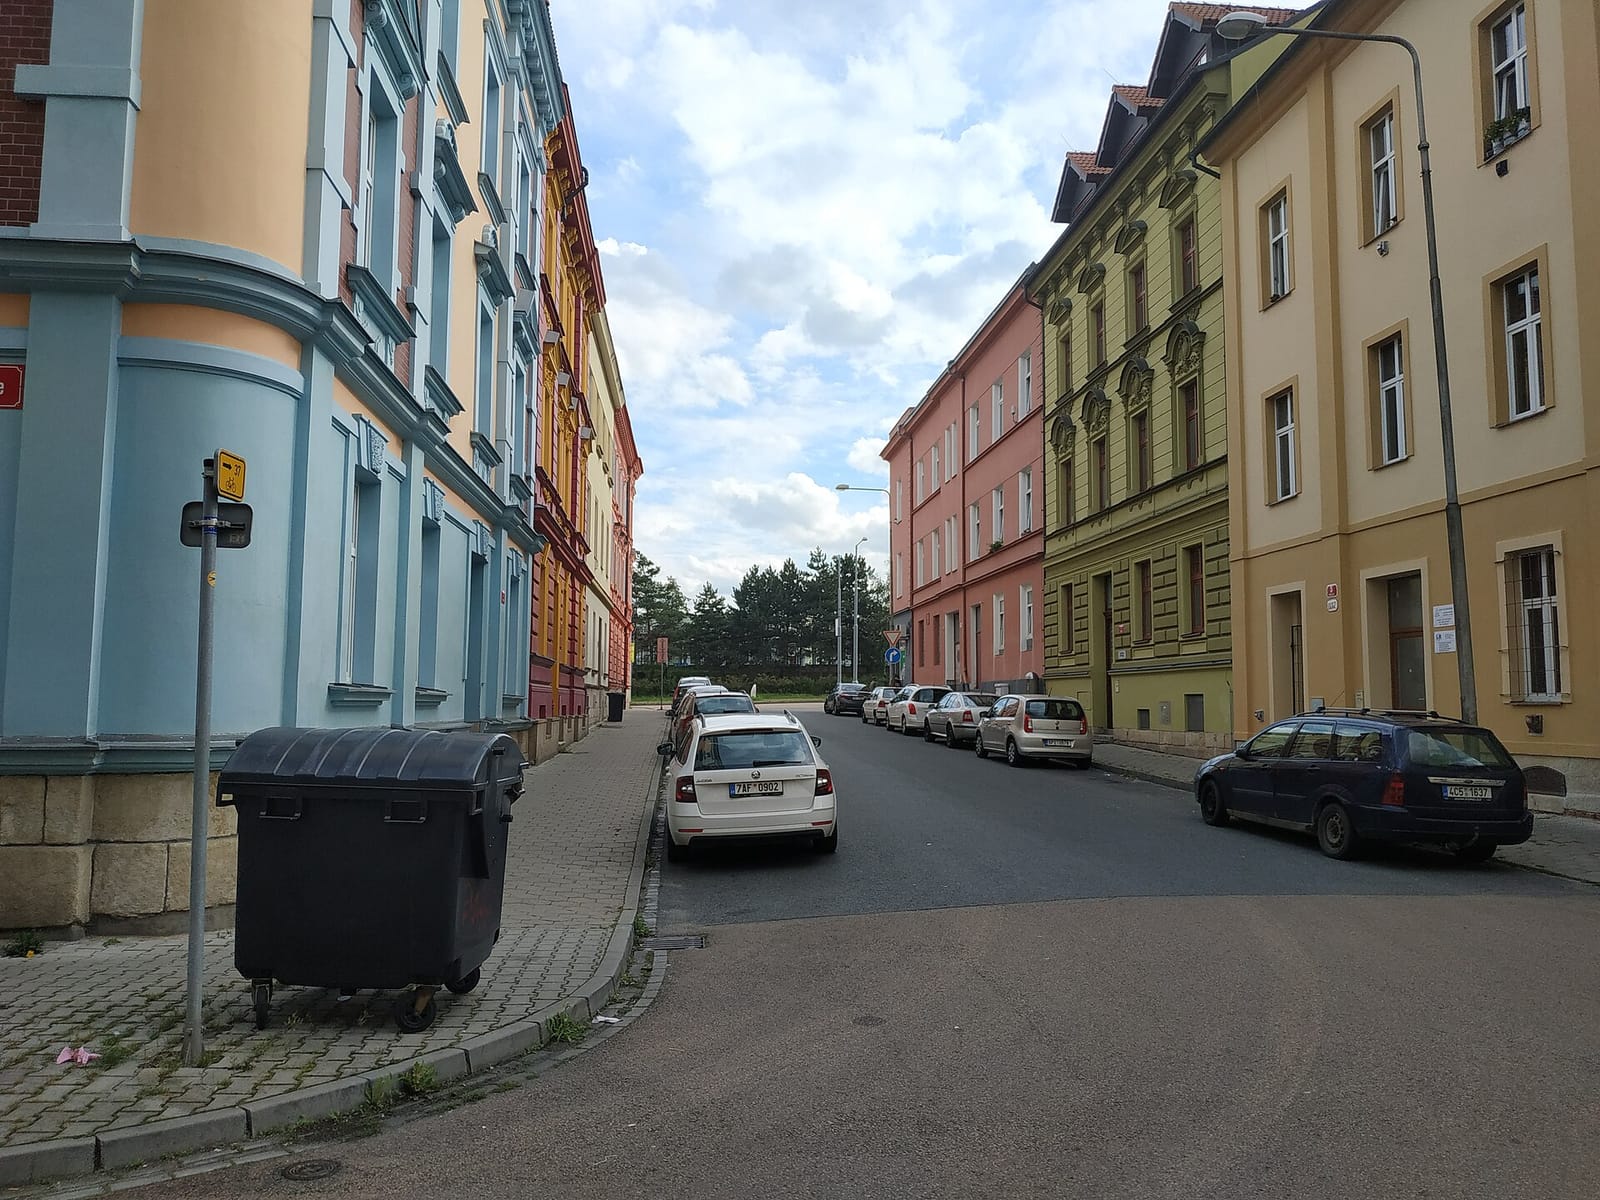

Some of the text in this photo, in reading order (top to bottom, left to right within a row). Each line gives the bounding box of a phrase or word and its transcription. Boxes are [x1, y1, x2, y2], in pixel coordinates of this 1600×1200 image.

[736, 782, 779, 793] 7AF 0902
[1470, 787, 1488, 797] 1637
